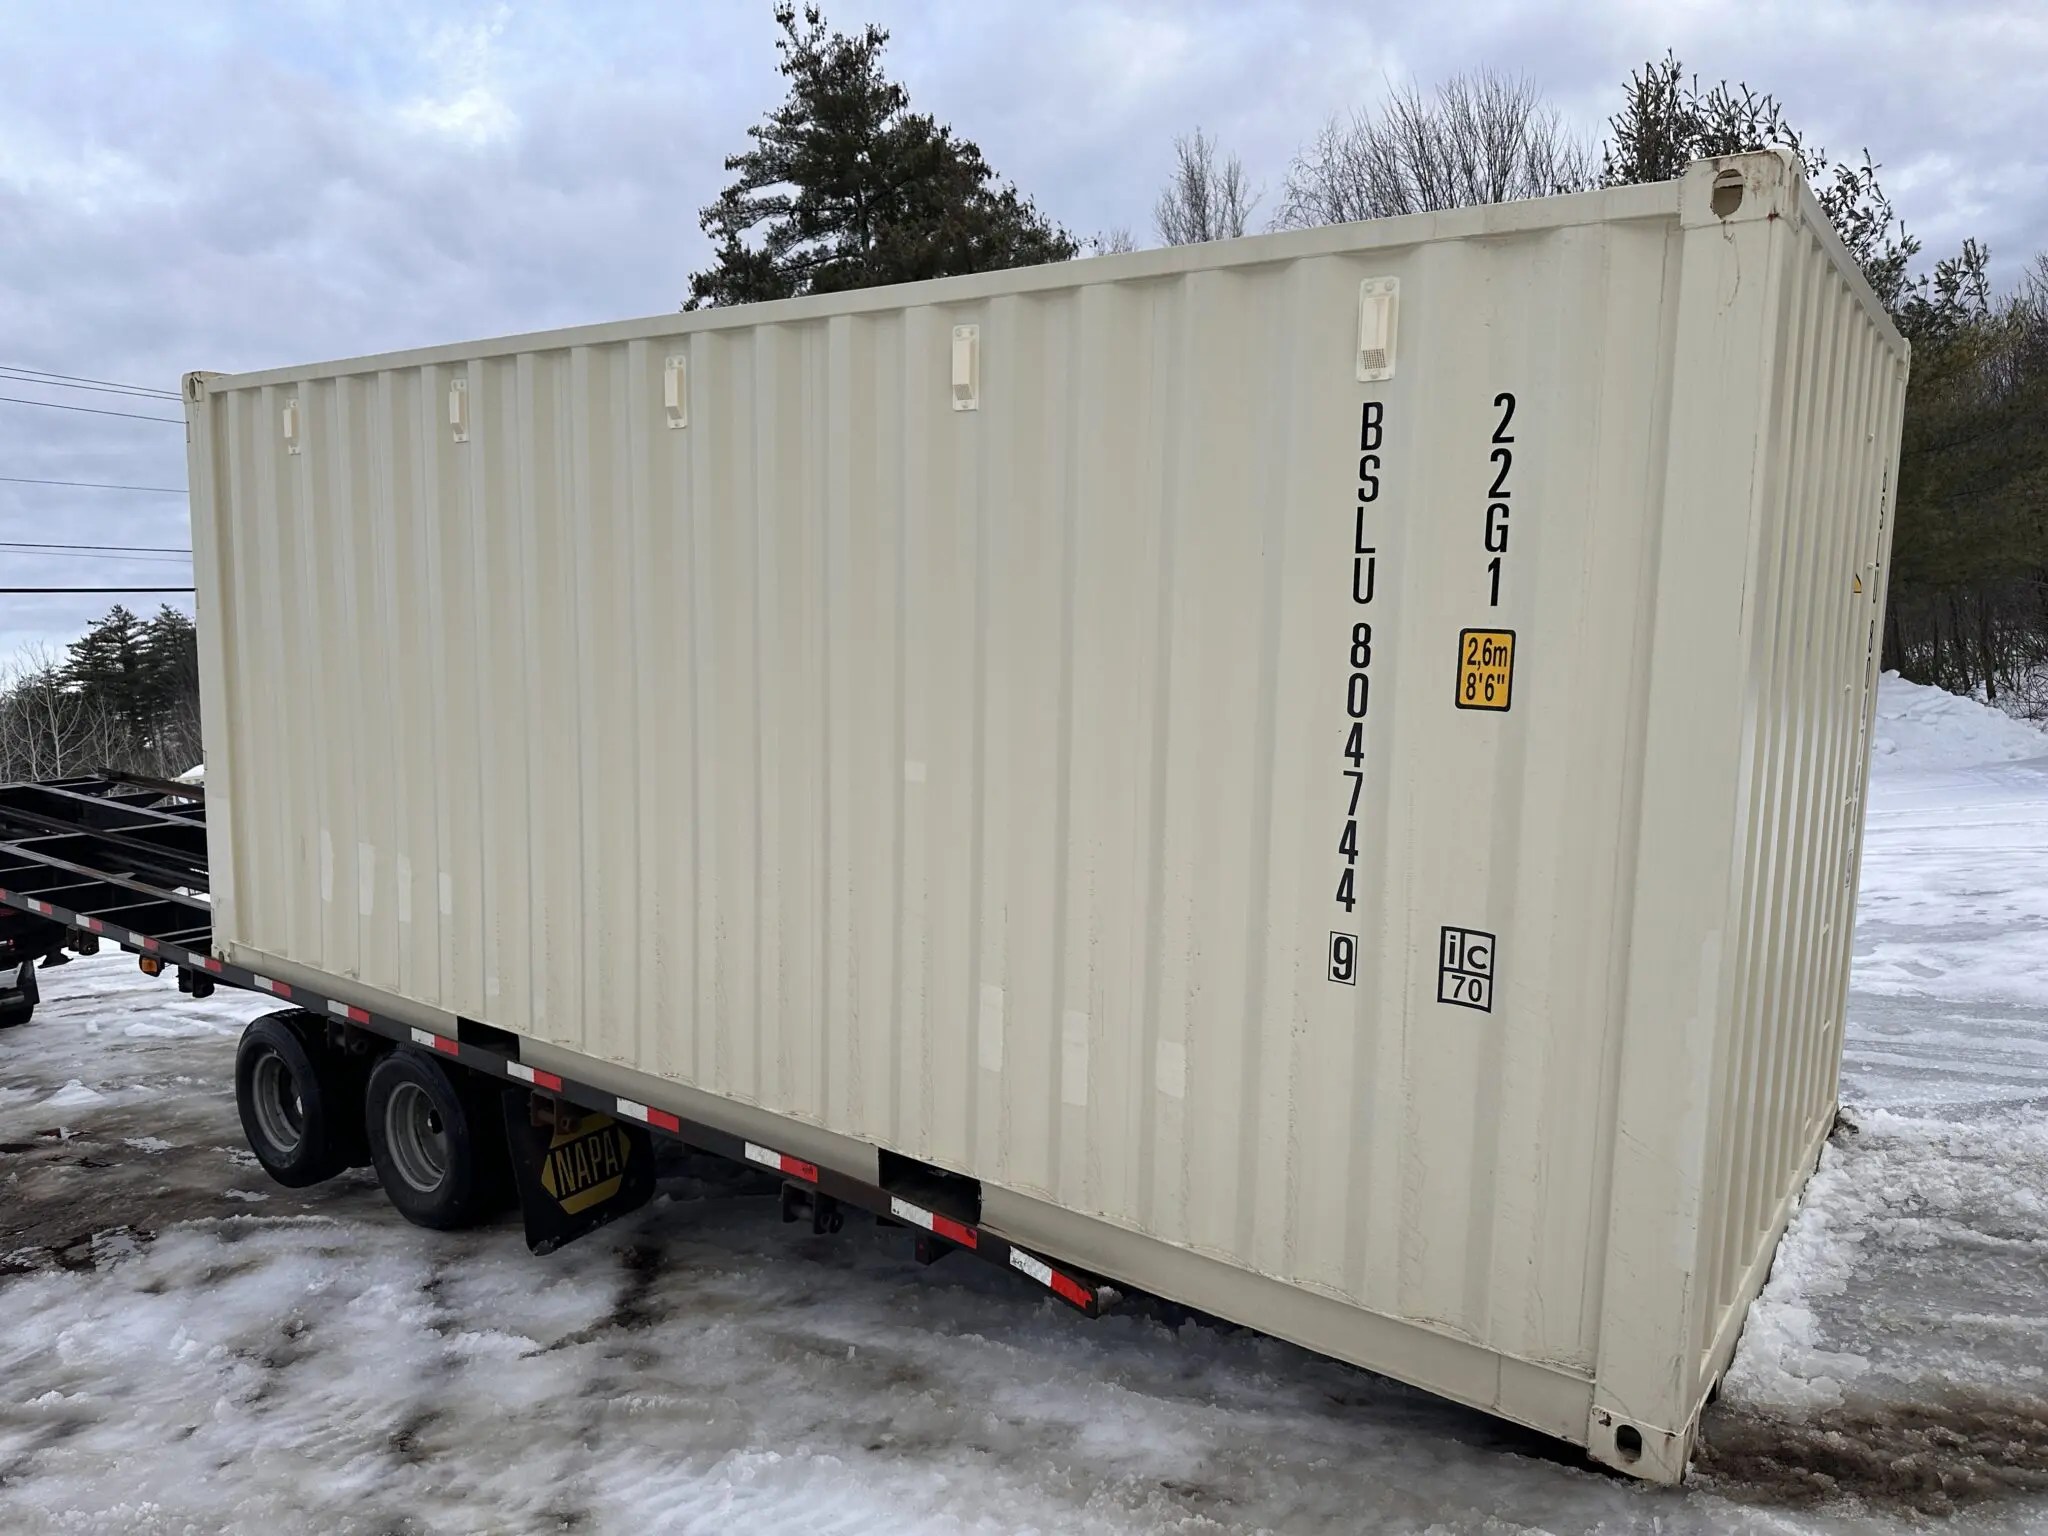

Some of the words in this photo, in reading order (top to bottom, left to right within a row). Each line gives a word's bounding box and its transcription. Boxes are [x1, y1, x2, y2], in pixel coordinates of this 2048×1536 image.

[1353, 402, 1383, 605] BSLU
[1485, 393, 1516, 607] 22G1
[1467, 637, 1507, 670] 2,6m
[1466, 673, 1505, 701] 8'6"
[1336, 623, 1371, 913] 804744
[1332, 936, 1354, 981] 9
[1452, 975, 1482, 1002] 70
[555, 1131, 618, 1195] NAPA
